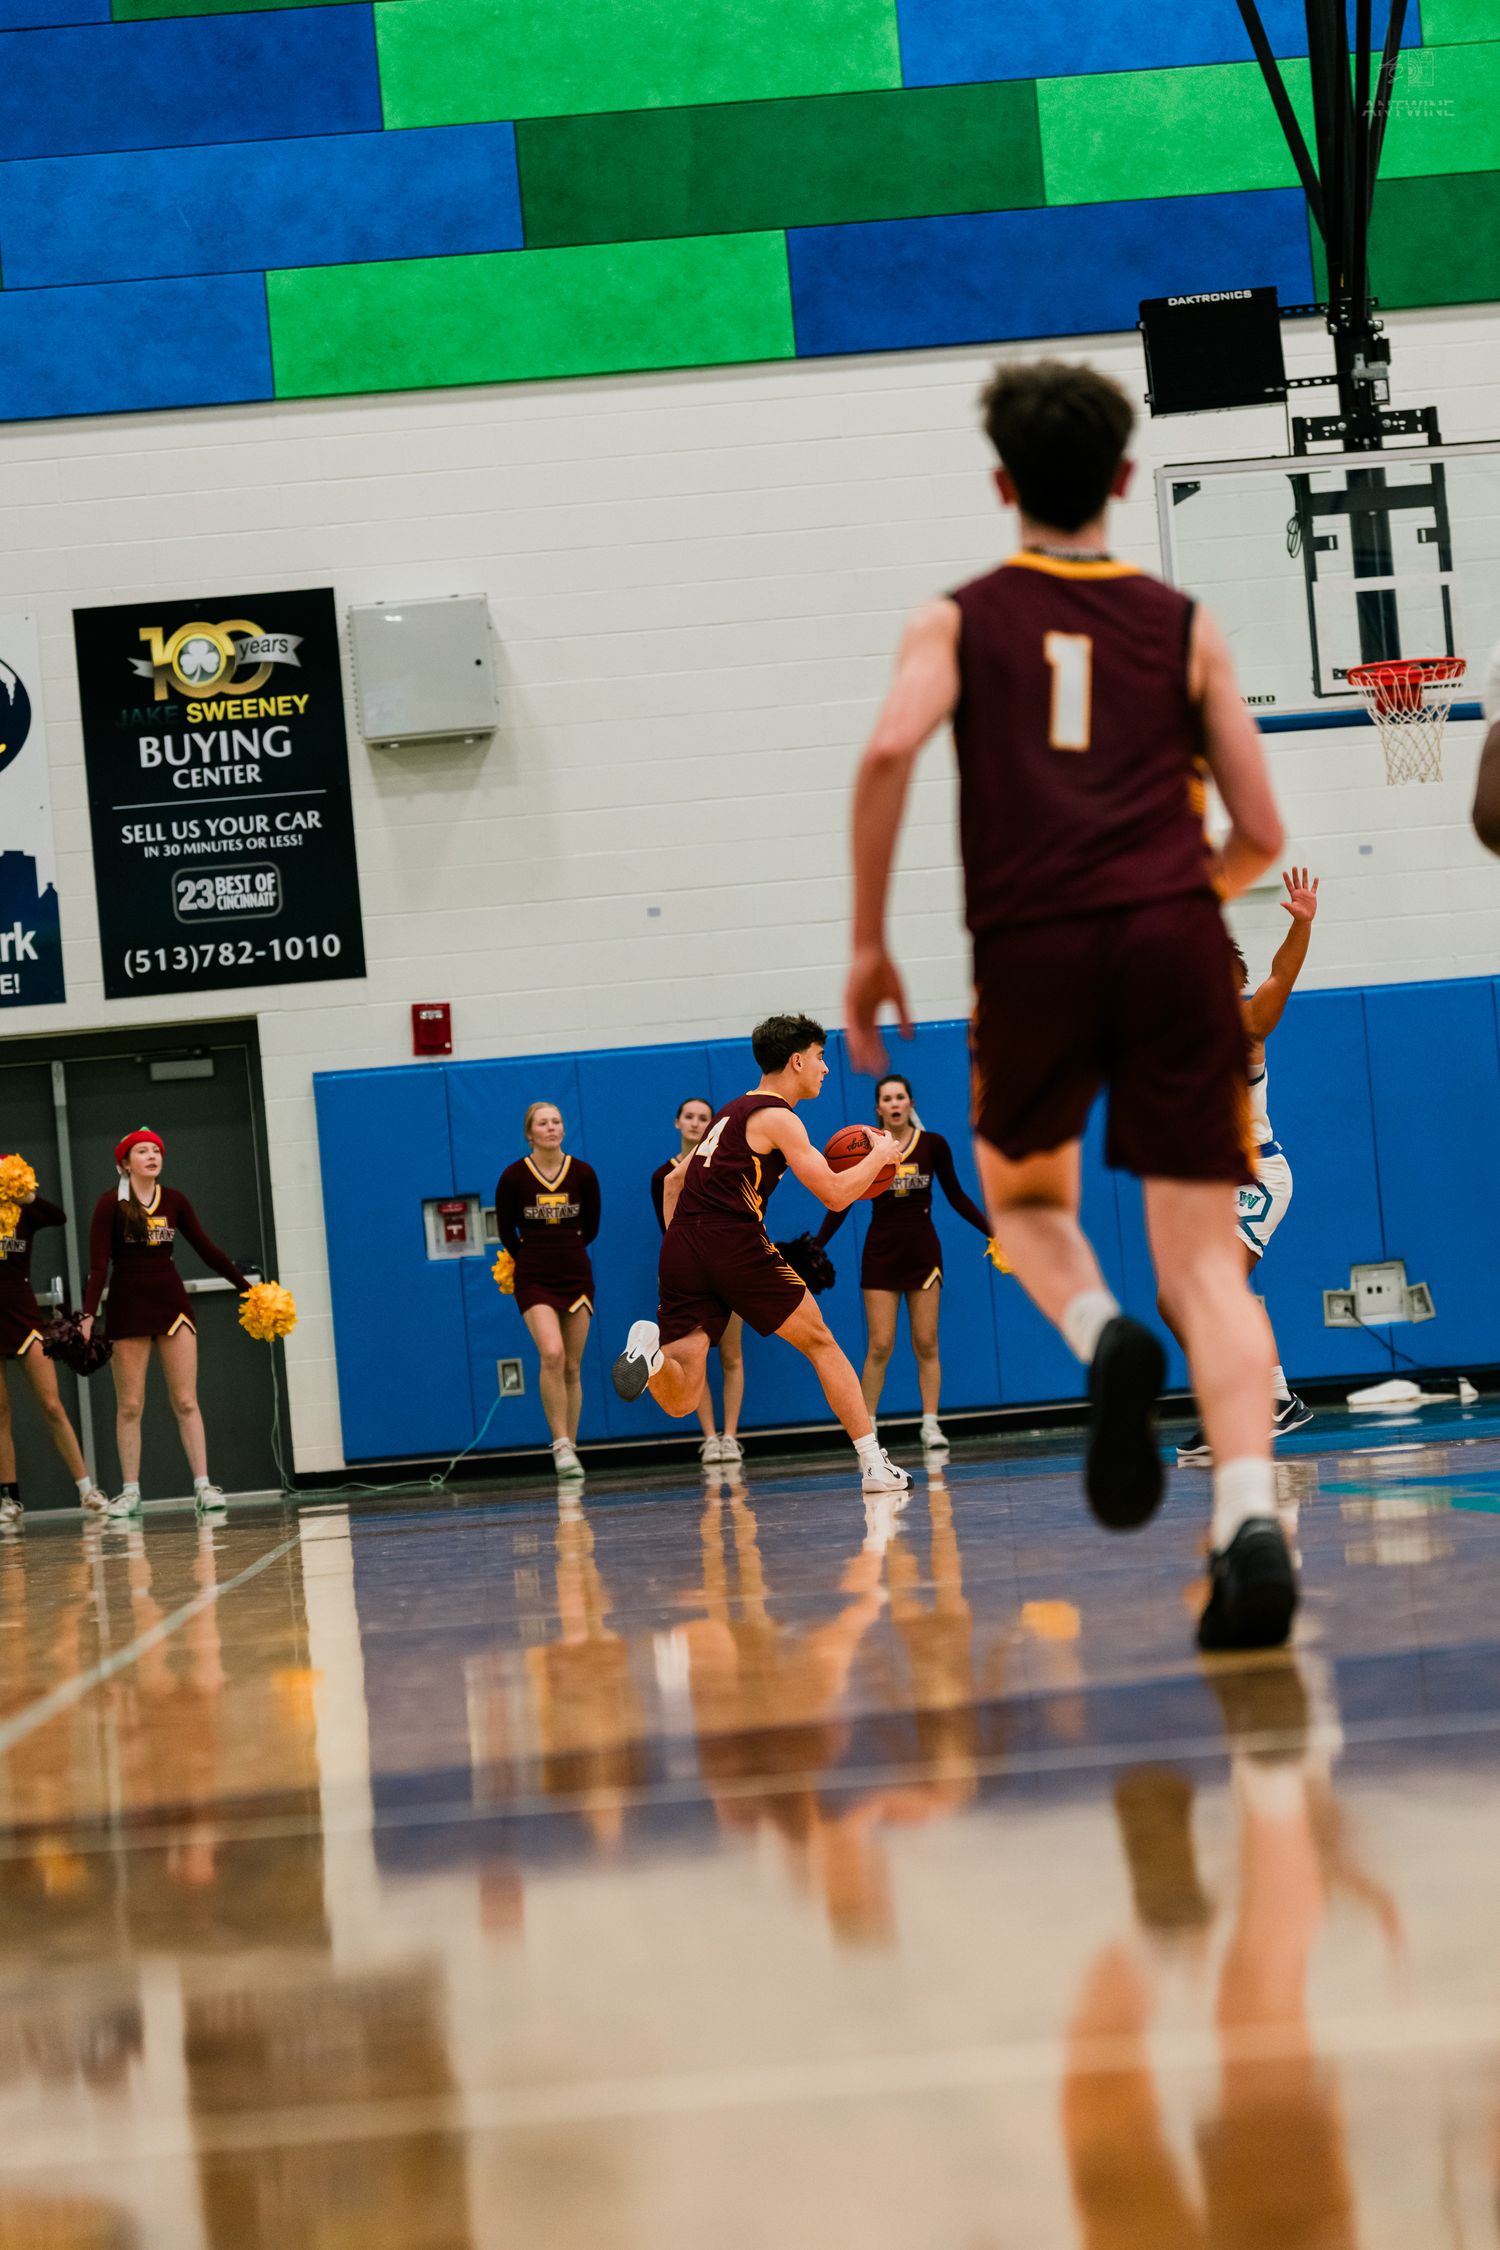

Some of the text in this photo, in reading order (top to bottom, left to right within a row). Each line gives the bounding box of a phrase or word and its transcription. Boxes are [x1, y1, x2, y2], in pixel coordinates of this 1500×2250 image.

[1167, 290, 1252, 306] DAKTRONICS
[239, 637, 289, 659] years
[1043, 630, 1093, 752] 1
[116, 694, 309, 729] JAKE SWEENEY
[139, 725, 292, 768] BUYING
[172, 763, 262, 789] CENTER
[121, 810, 322, 844] SELL US YOUR CAR
[144, 834, 303, 858] IN 30 MINUTES OR LESS!
[177, 872, 276, 911] 23 BEST OF
[216, 891, 276, 911] CINCINNATI
[124, 933, 341, 979] (513)782-1010
[695, 1116, 731, 1168] 4
[524, 1204, 580, 1219] SPARTANS
